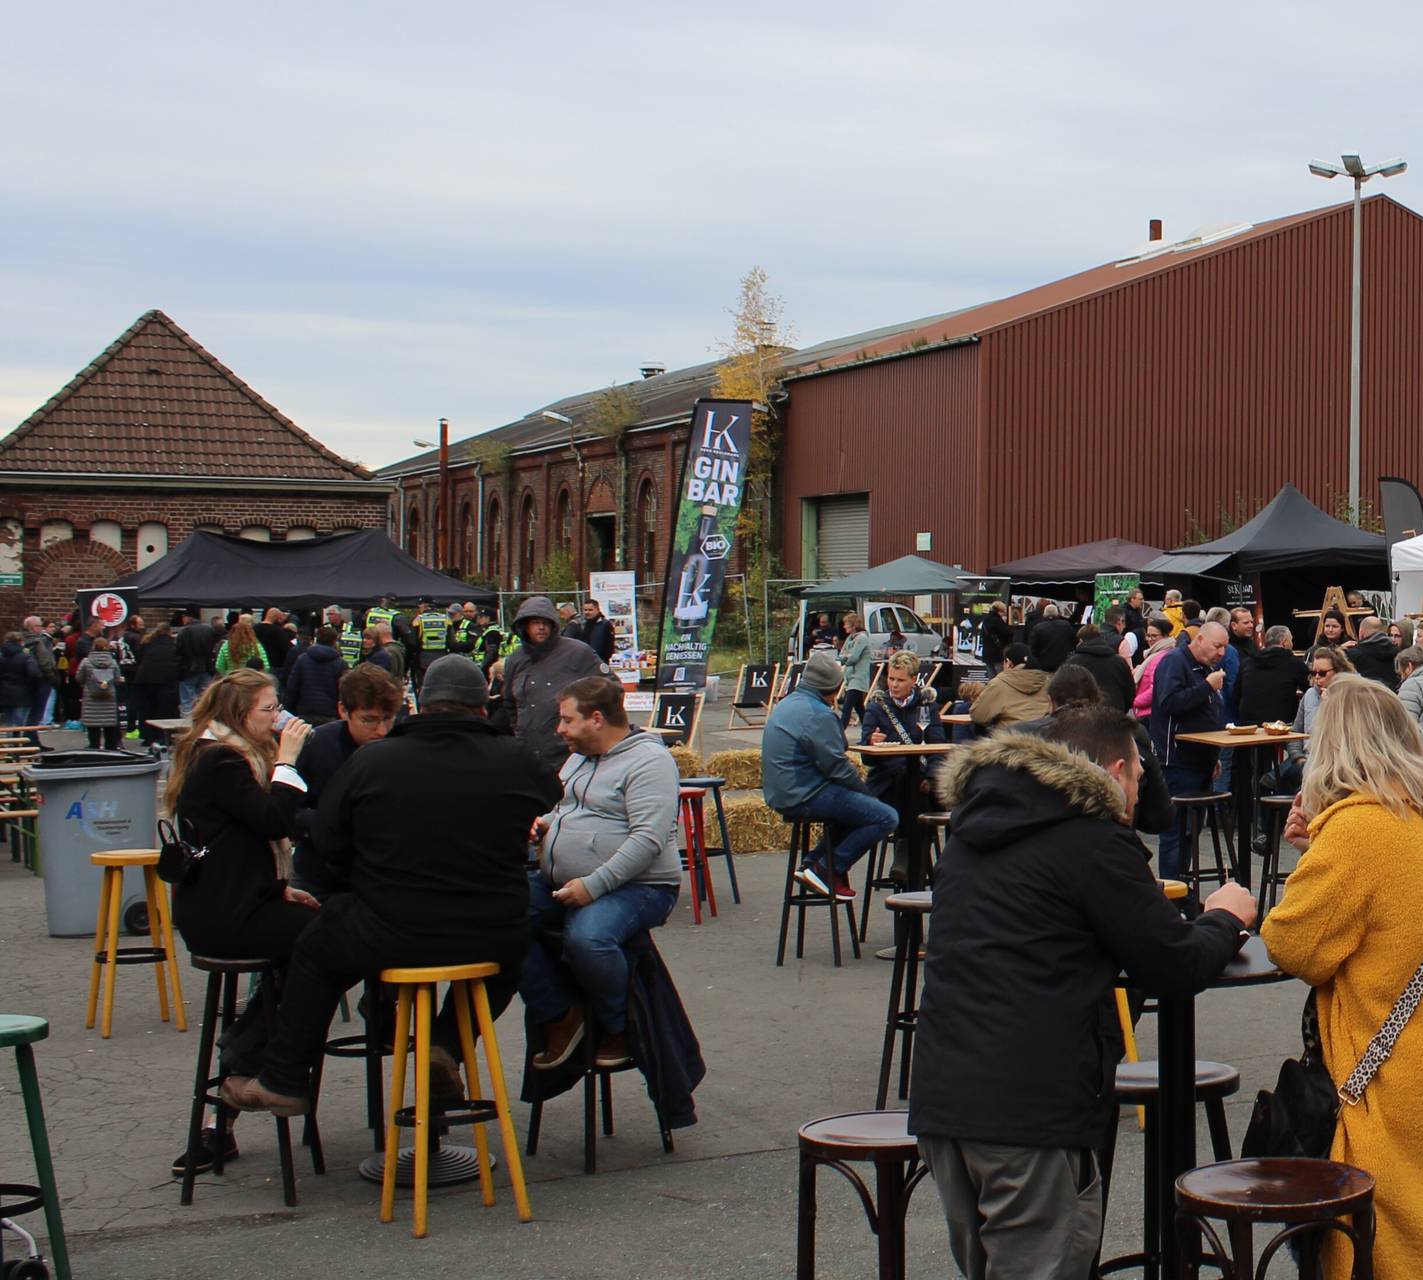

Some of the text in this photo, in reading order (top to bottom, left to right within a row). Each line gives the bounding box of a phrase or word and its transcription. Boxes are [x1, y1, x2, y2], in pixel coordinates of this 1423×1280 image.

[694, 456, 740, 483] GIN
[687, 479, 739, 506] BAR
[705, 540, 726, 551] BIO
[65, 801, 118, 820] ASH
